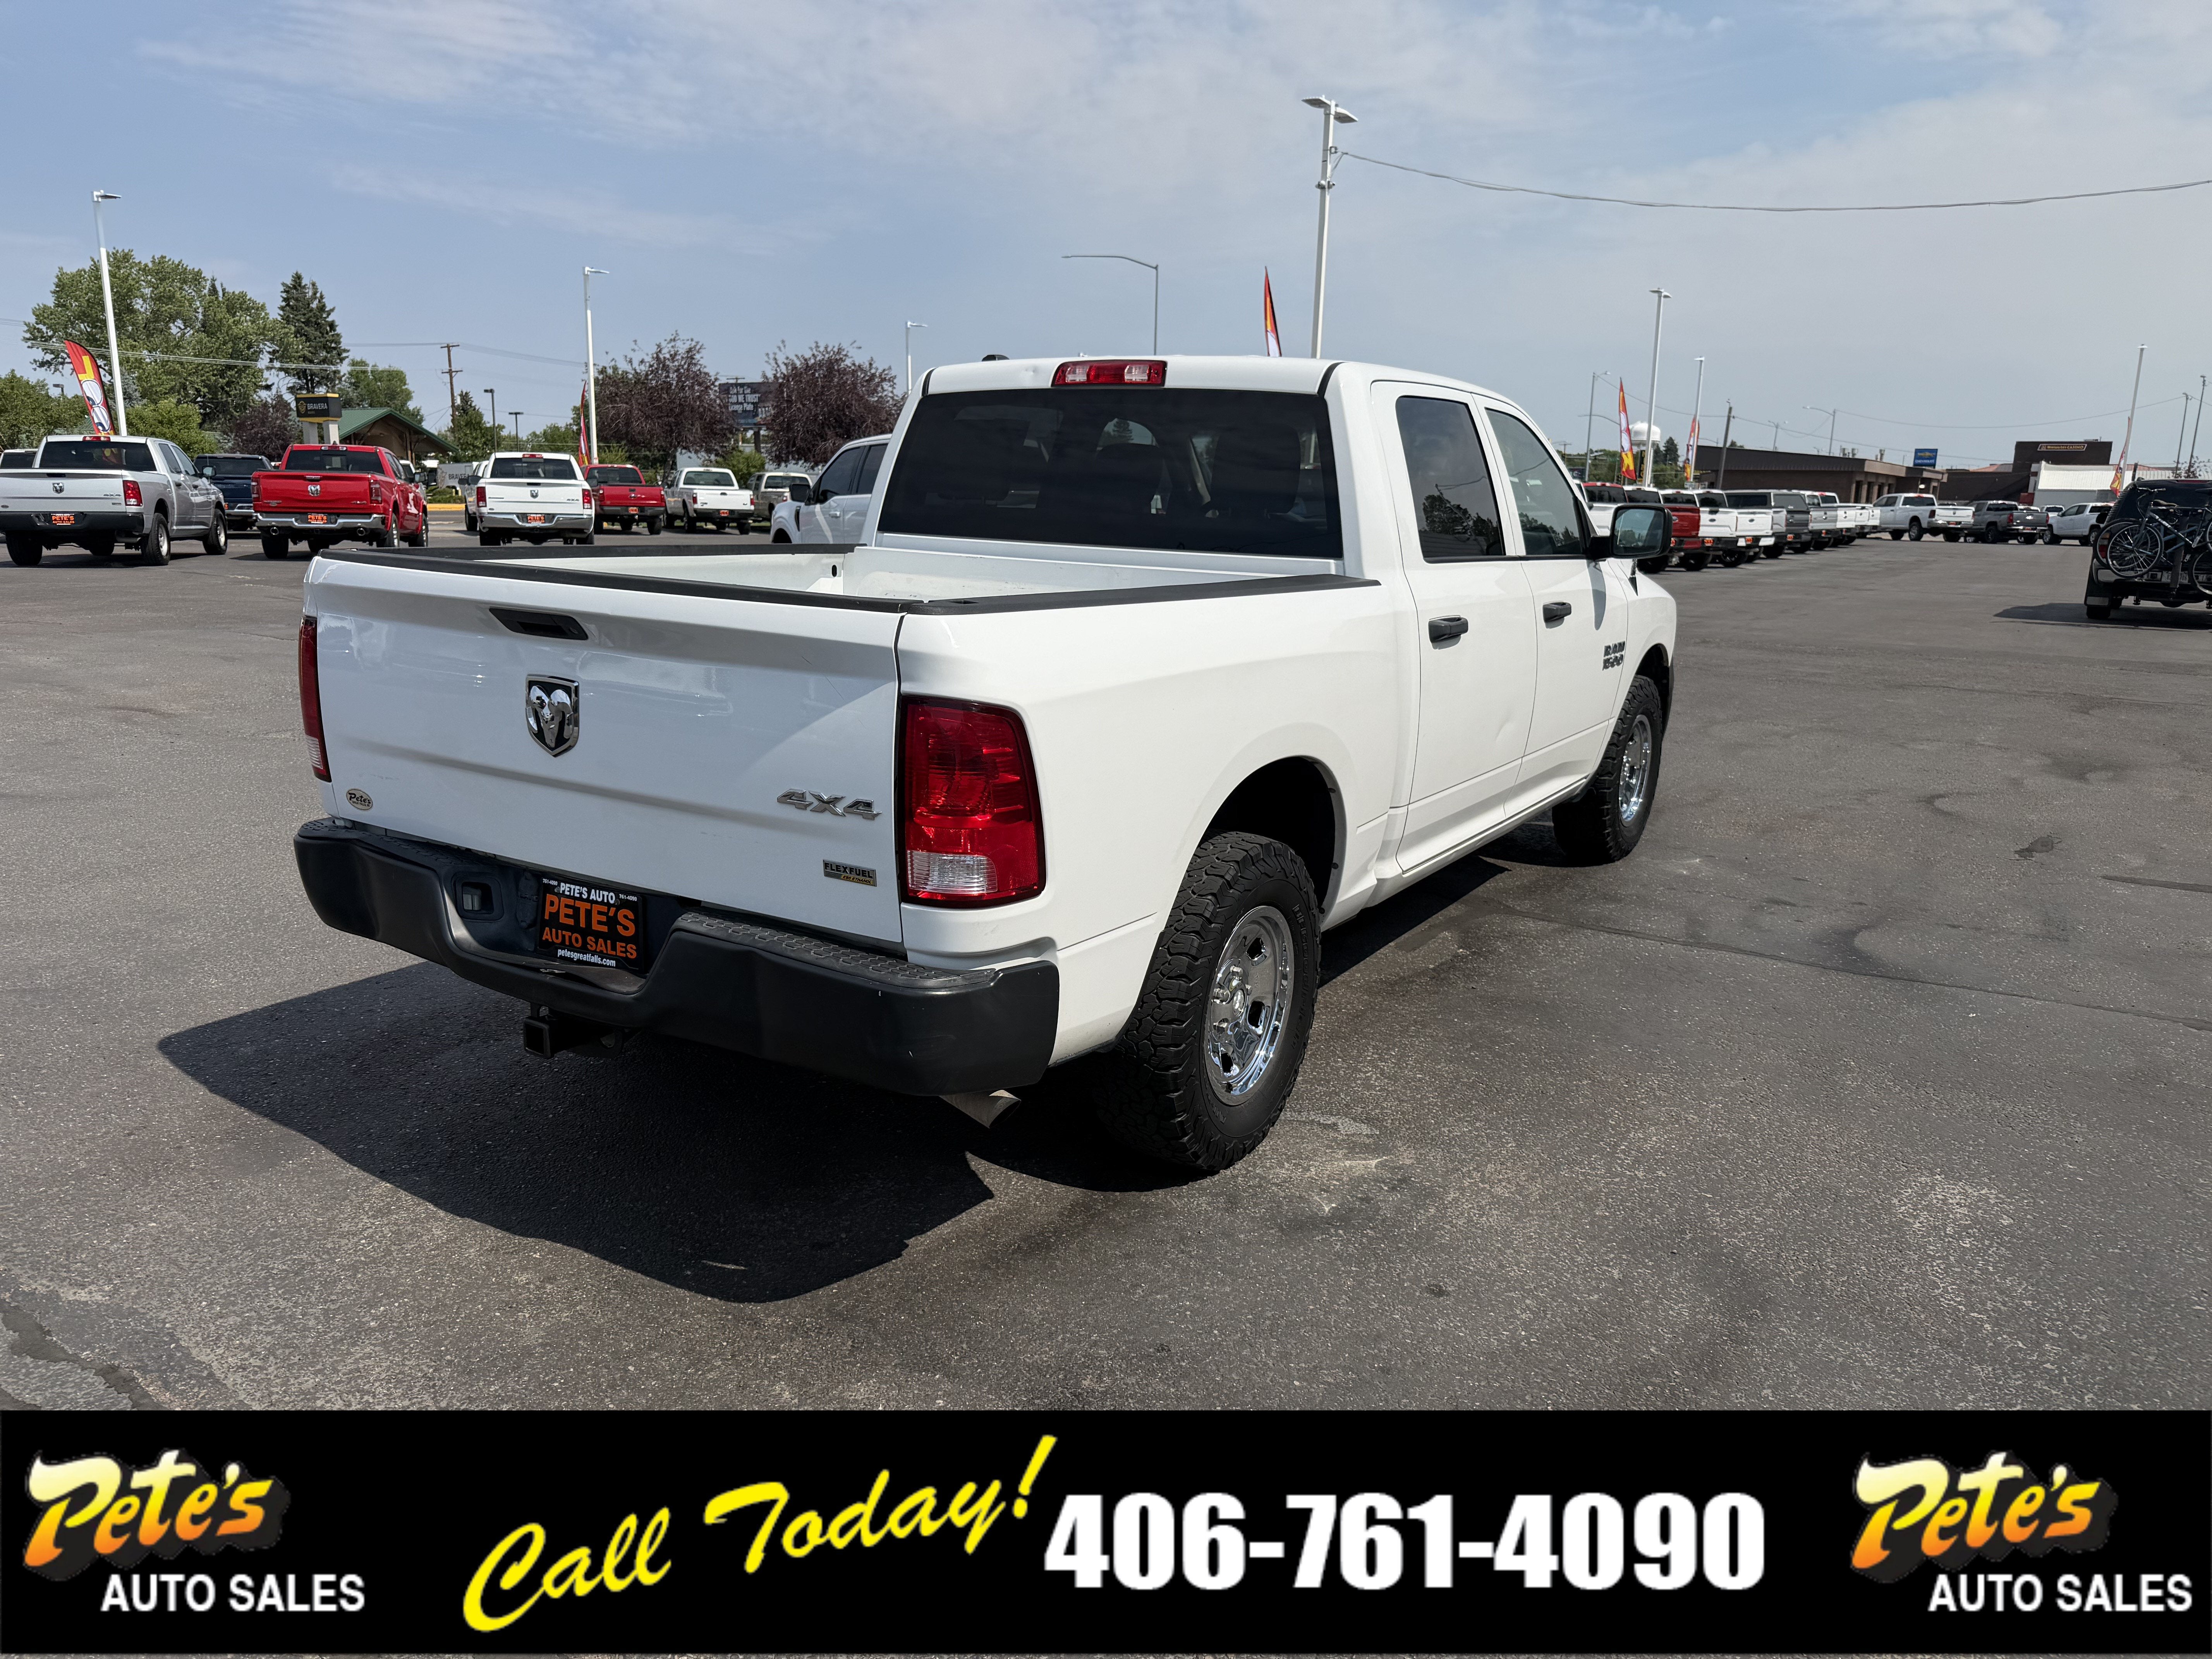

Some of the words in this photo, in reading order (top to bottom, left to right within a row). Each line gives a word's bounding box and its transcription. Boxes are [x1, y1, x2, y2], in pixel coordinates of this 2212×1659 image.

[1604, 641, 1625, 657] RAM
[348, 792, 371, 804] Pete's
[777, 788, 883, 821] 4X4
[560, 882, 588, 899] PETE'S
[589, 889, 615, 904] AUTO
[619, 893, 637, 902] 761-4090
[544, 893, 635, 936] PETE'S
[542, 927, 582, 948] AUTO
[587, 936, 637, 958] SALES
[558, 948, 616, 967] petesgreatfalls.com
